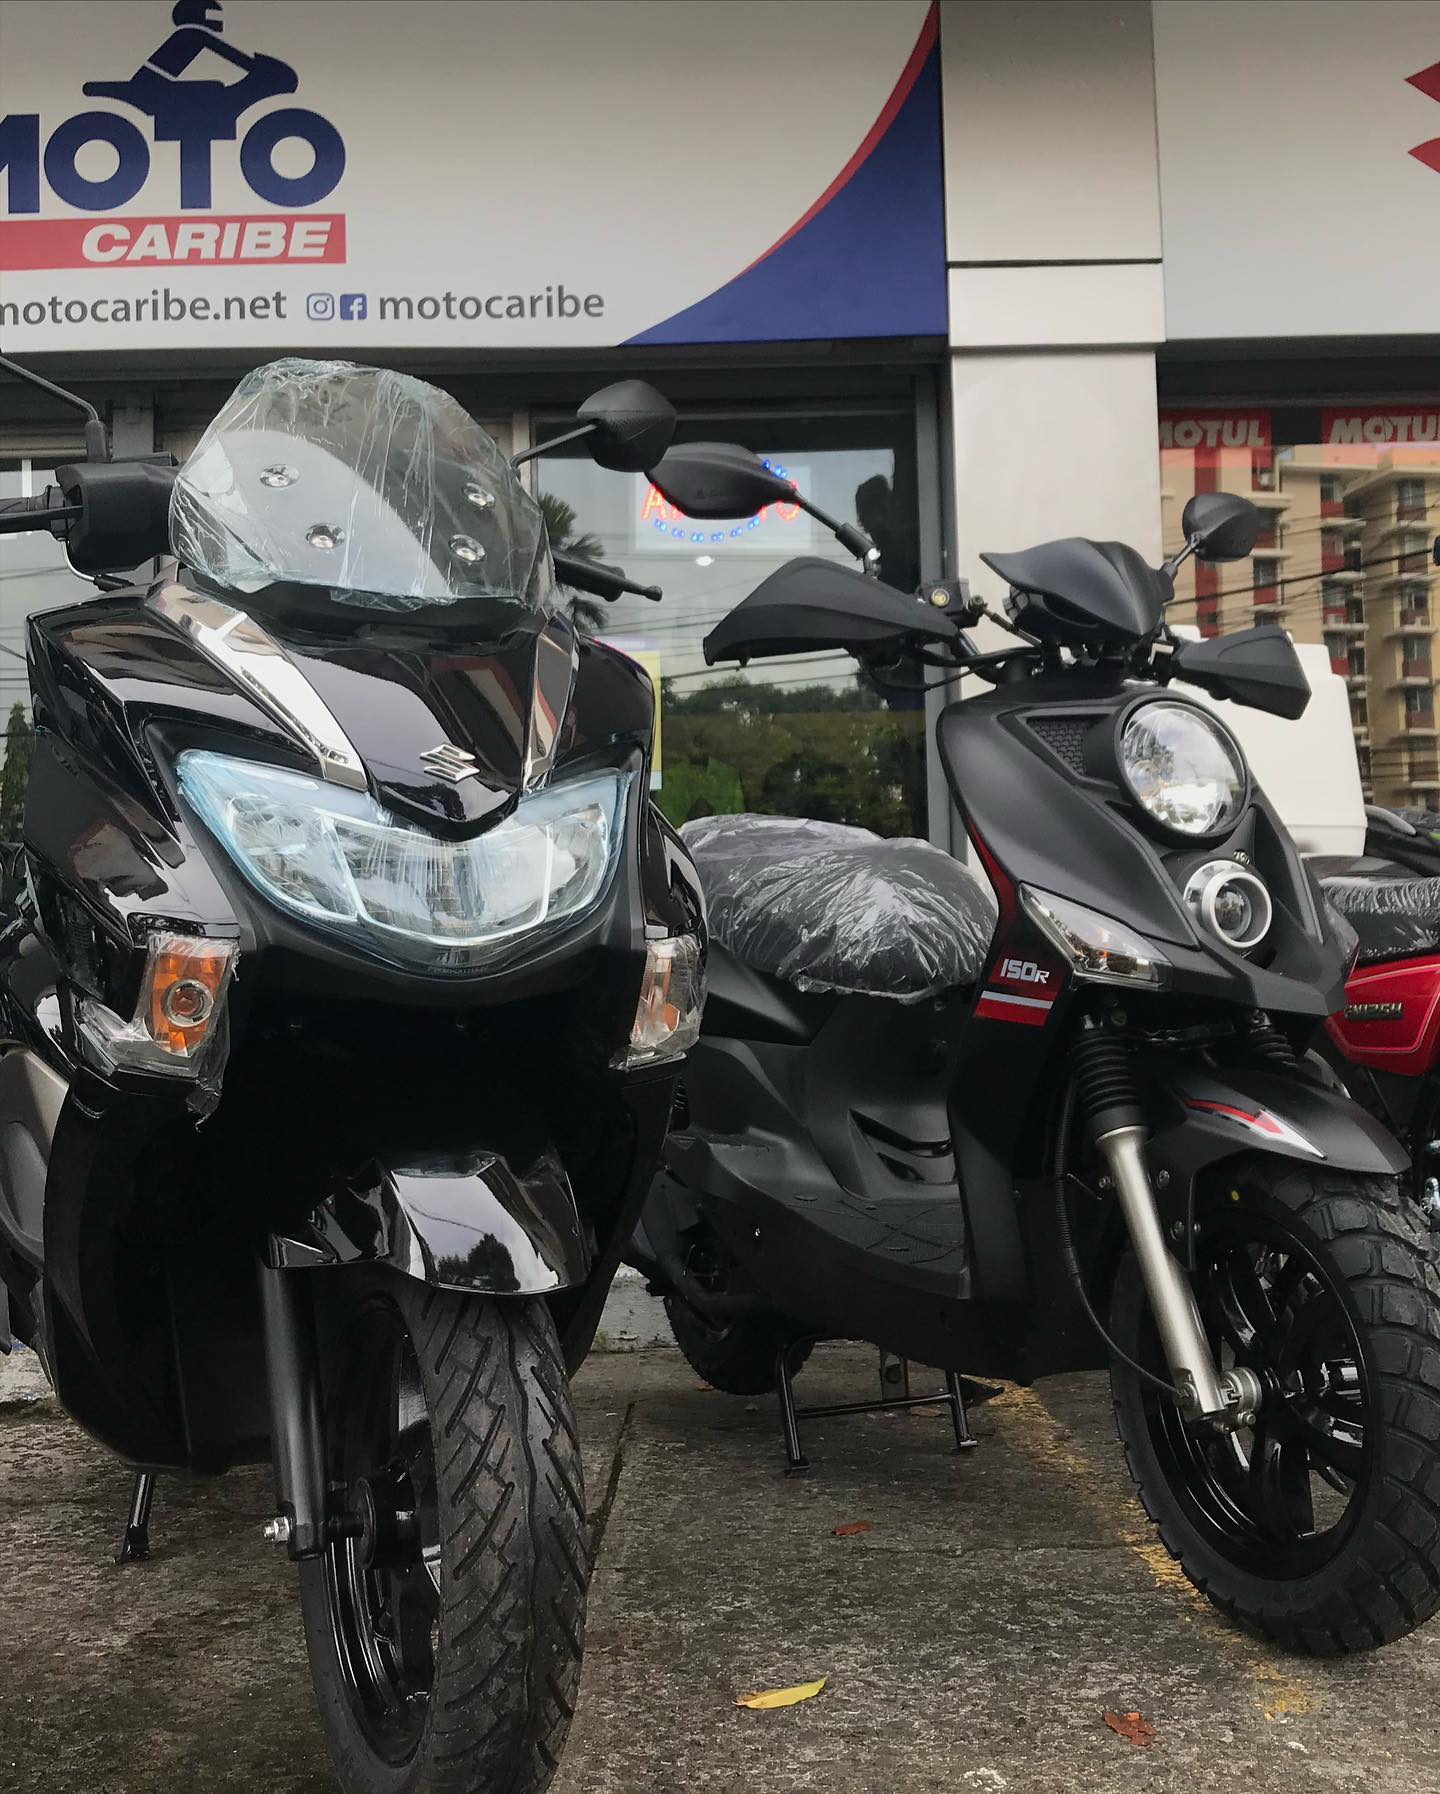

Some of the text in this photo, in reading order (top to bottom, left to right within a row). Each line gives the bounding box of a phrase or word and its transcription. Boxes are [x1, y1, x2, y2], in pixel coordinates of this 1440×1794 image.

[81, 221, 333, 263] CARIBE
[379, 286, 604, 320] motocaribe
[1329, 415, 1440, 444] MOTU
